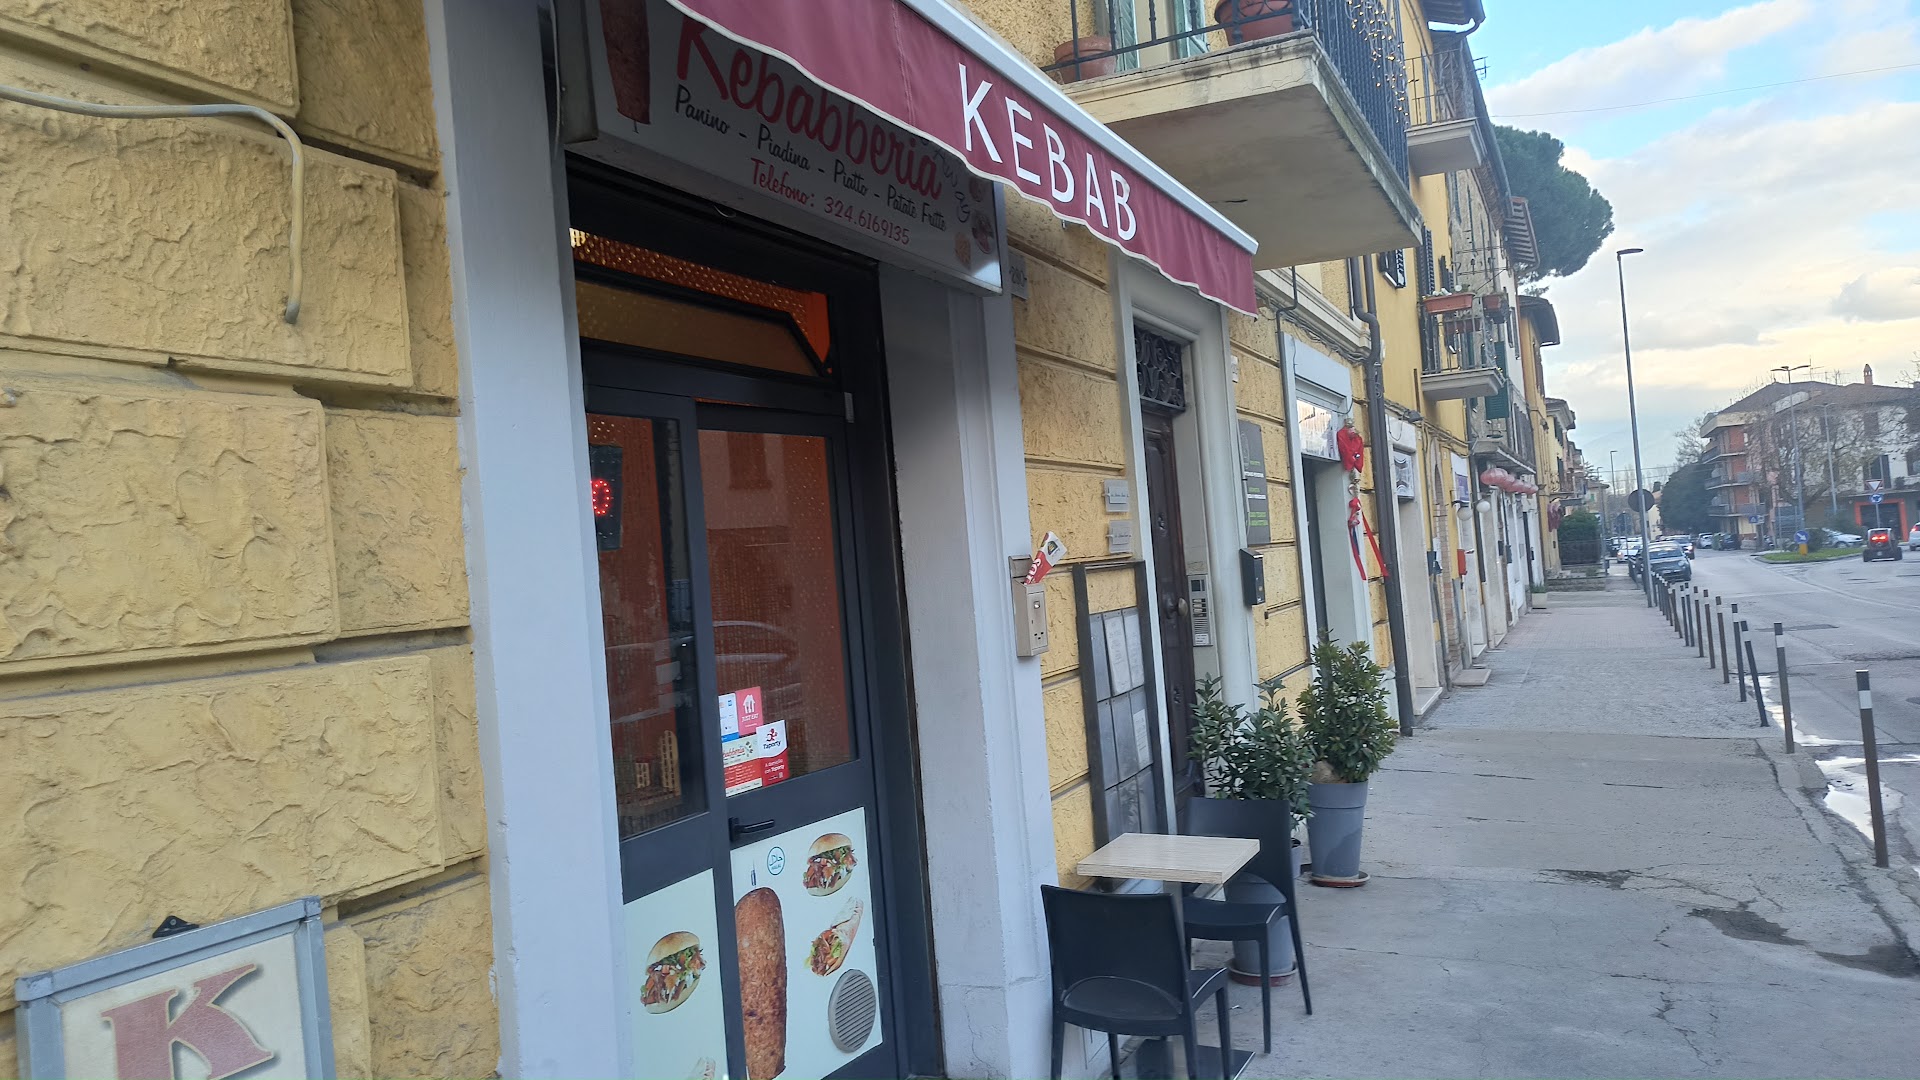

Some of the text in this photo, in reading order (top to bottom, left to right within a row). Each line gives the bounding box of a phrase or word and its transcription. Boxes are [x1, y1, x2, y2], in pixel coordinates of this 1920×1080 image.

[675, 84, 730, 134] Panino
[757, 123, 811, 170] Piadina
[833, 159, 869, 196] Piatto
[887, 184, 917, 218] Patate
[750, 157, 910, 245] Telefono: 324.6169135
[958, 62, 1137, 241] KEBAB
[101, 963, 274, 1080] K
